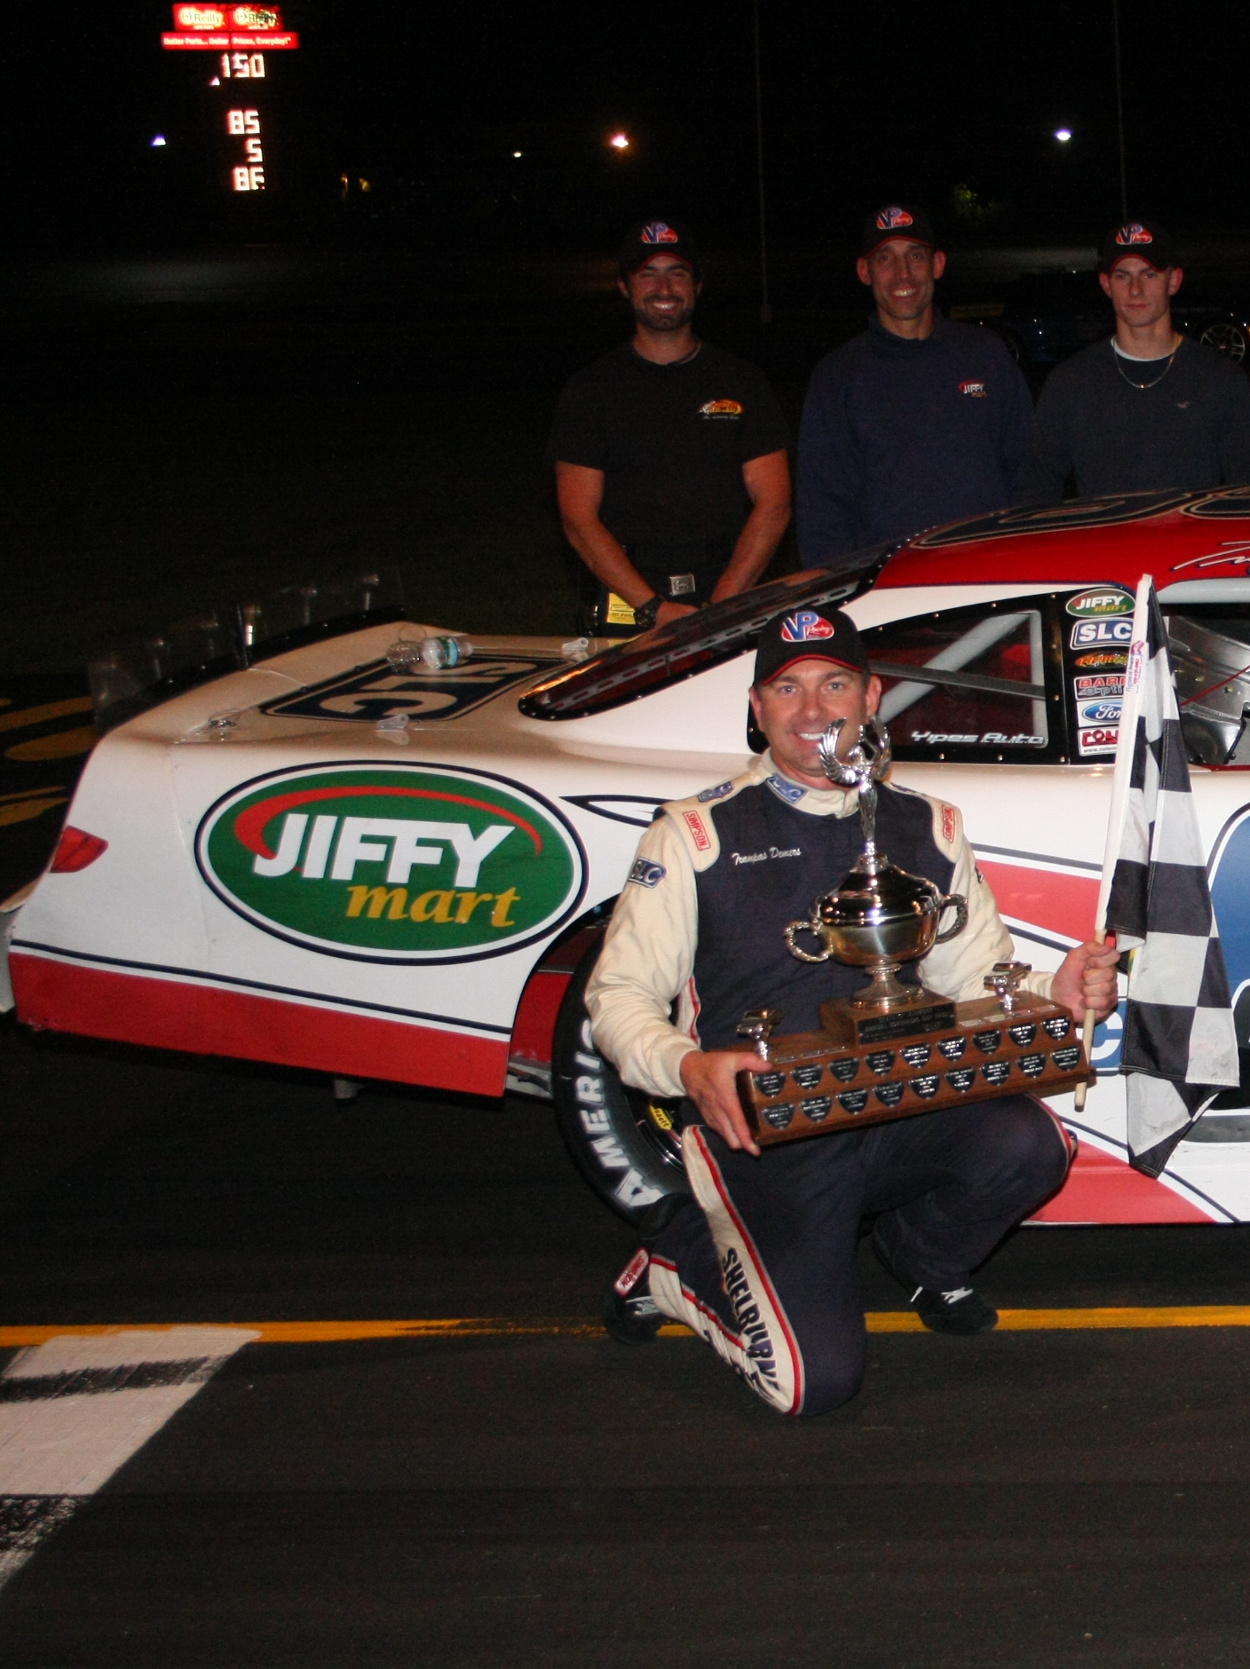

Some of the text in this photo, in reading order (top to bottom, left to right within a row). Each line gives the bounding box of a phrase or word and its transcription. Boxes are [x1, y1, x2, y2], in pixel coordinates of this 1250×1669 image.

[222, 52, 265, 78] 150
[228, 109, 260, 134] 85
[246, 138, 263, 162] 5
[1075, 595, 1125, 610] JIFFY
[782, 611, 819, 641] VP
[1079, 622, 1132, 642] SLC
[911, 730, 1044, 744] Yipes Auto
[685, 811, 709, 848] SIMPSON
[253, 813, 516, 888] JIFFY
[346, 885, 521, 928] mart
